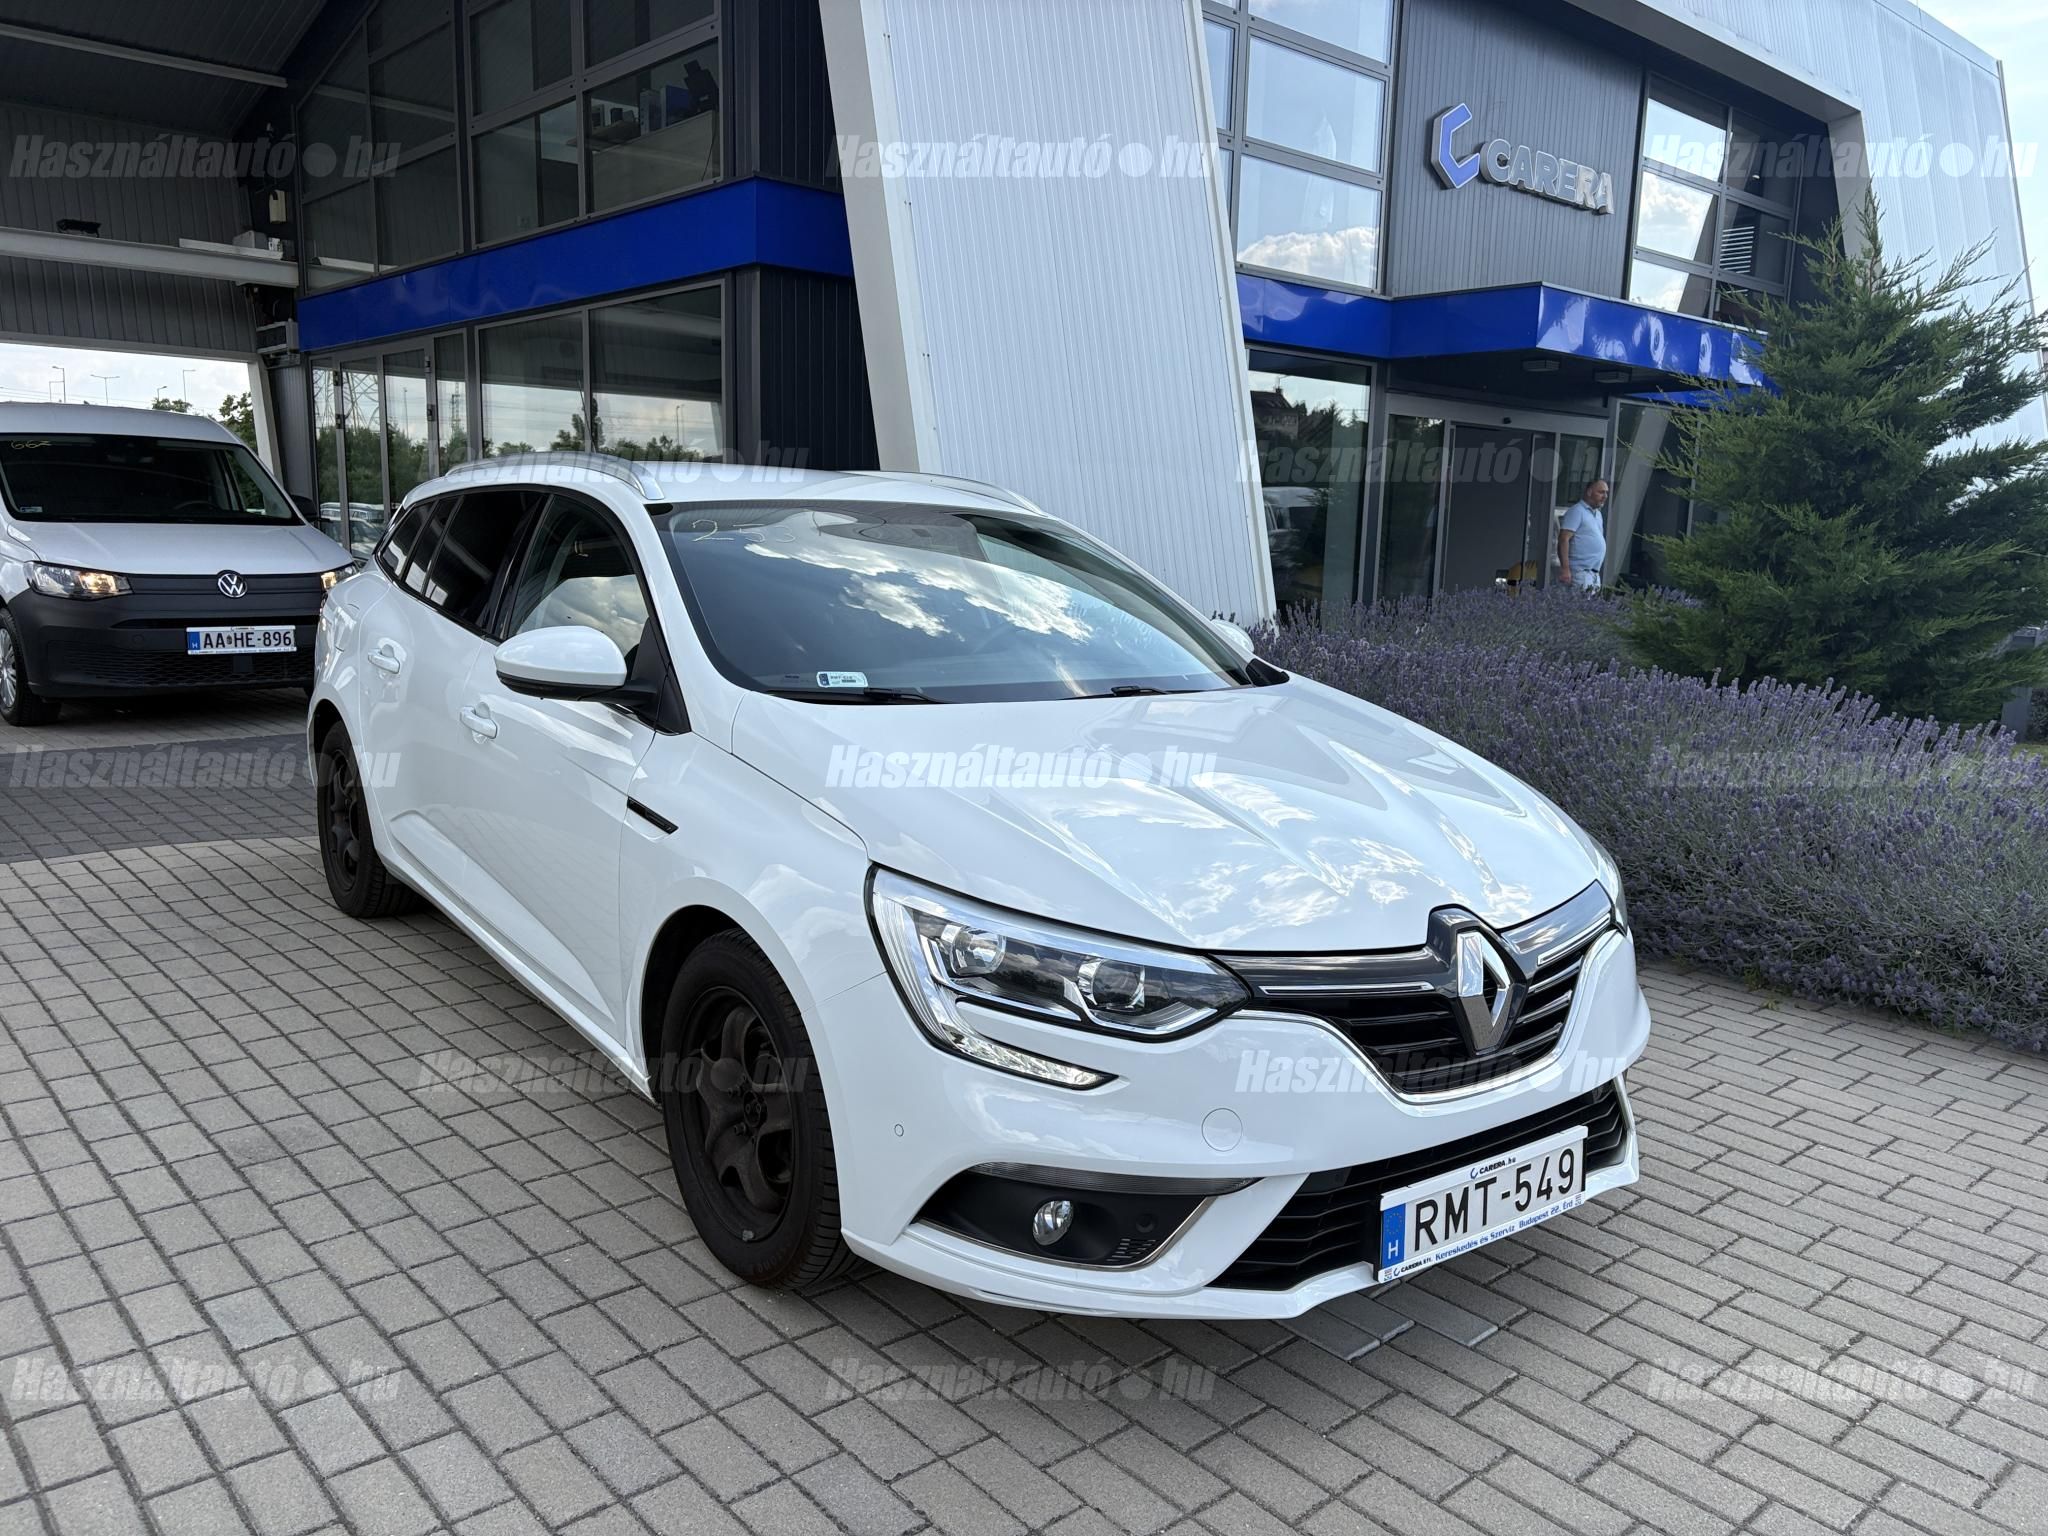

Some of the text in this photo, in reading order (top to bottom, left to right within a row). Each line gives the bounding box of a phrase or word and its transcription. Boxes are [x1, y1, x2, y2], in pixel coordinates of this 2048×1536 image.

[1481, 138, 1615, 214] CARERA
[1415, 1148, 1575, 1252] RMT-549
[1388, 1239, 1399, 1260] H
[1435, 1238, 1478, 1261] Kereskedés
[1490, 1225, 1515, 1239] Szerviz
[1519, 1211, 1549, 1228] Budapest
